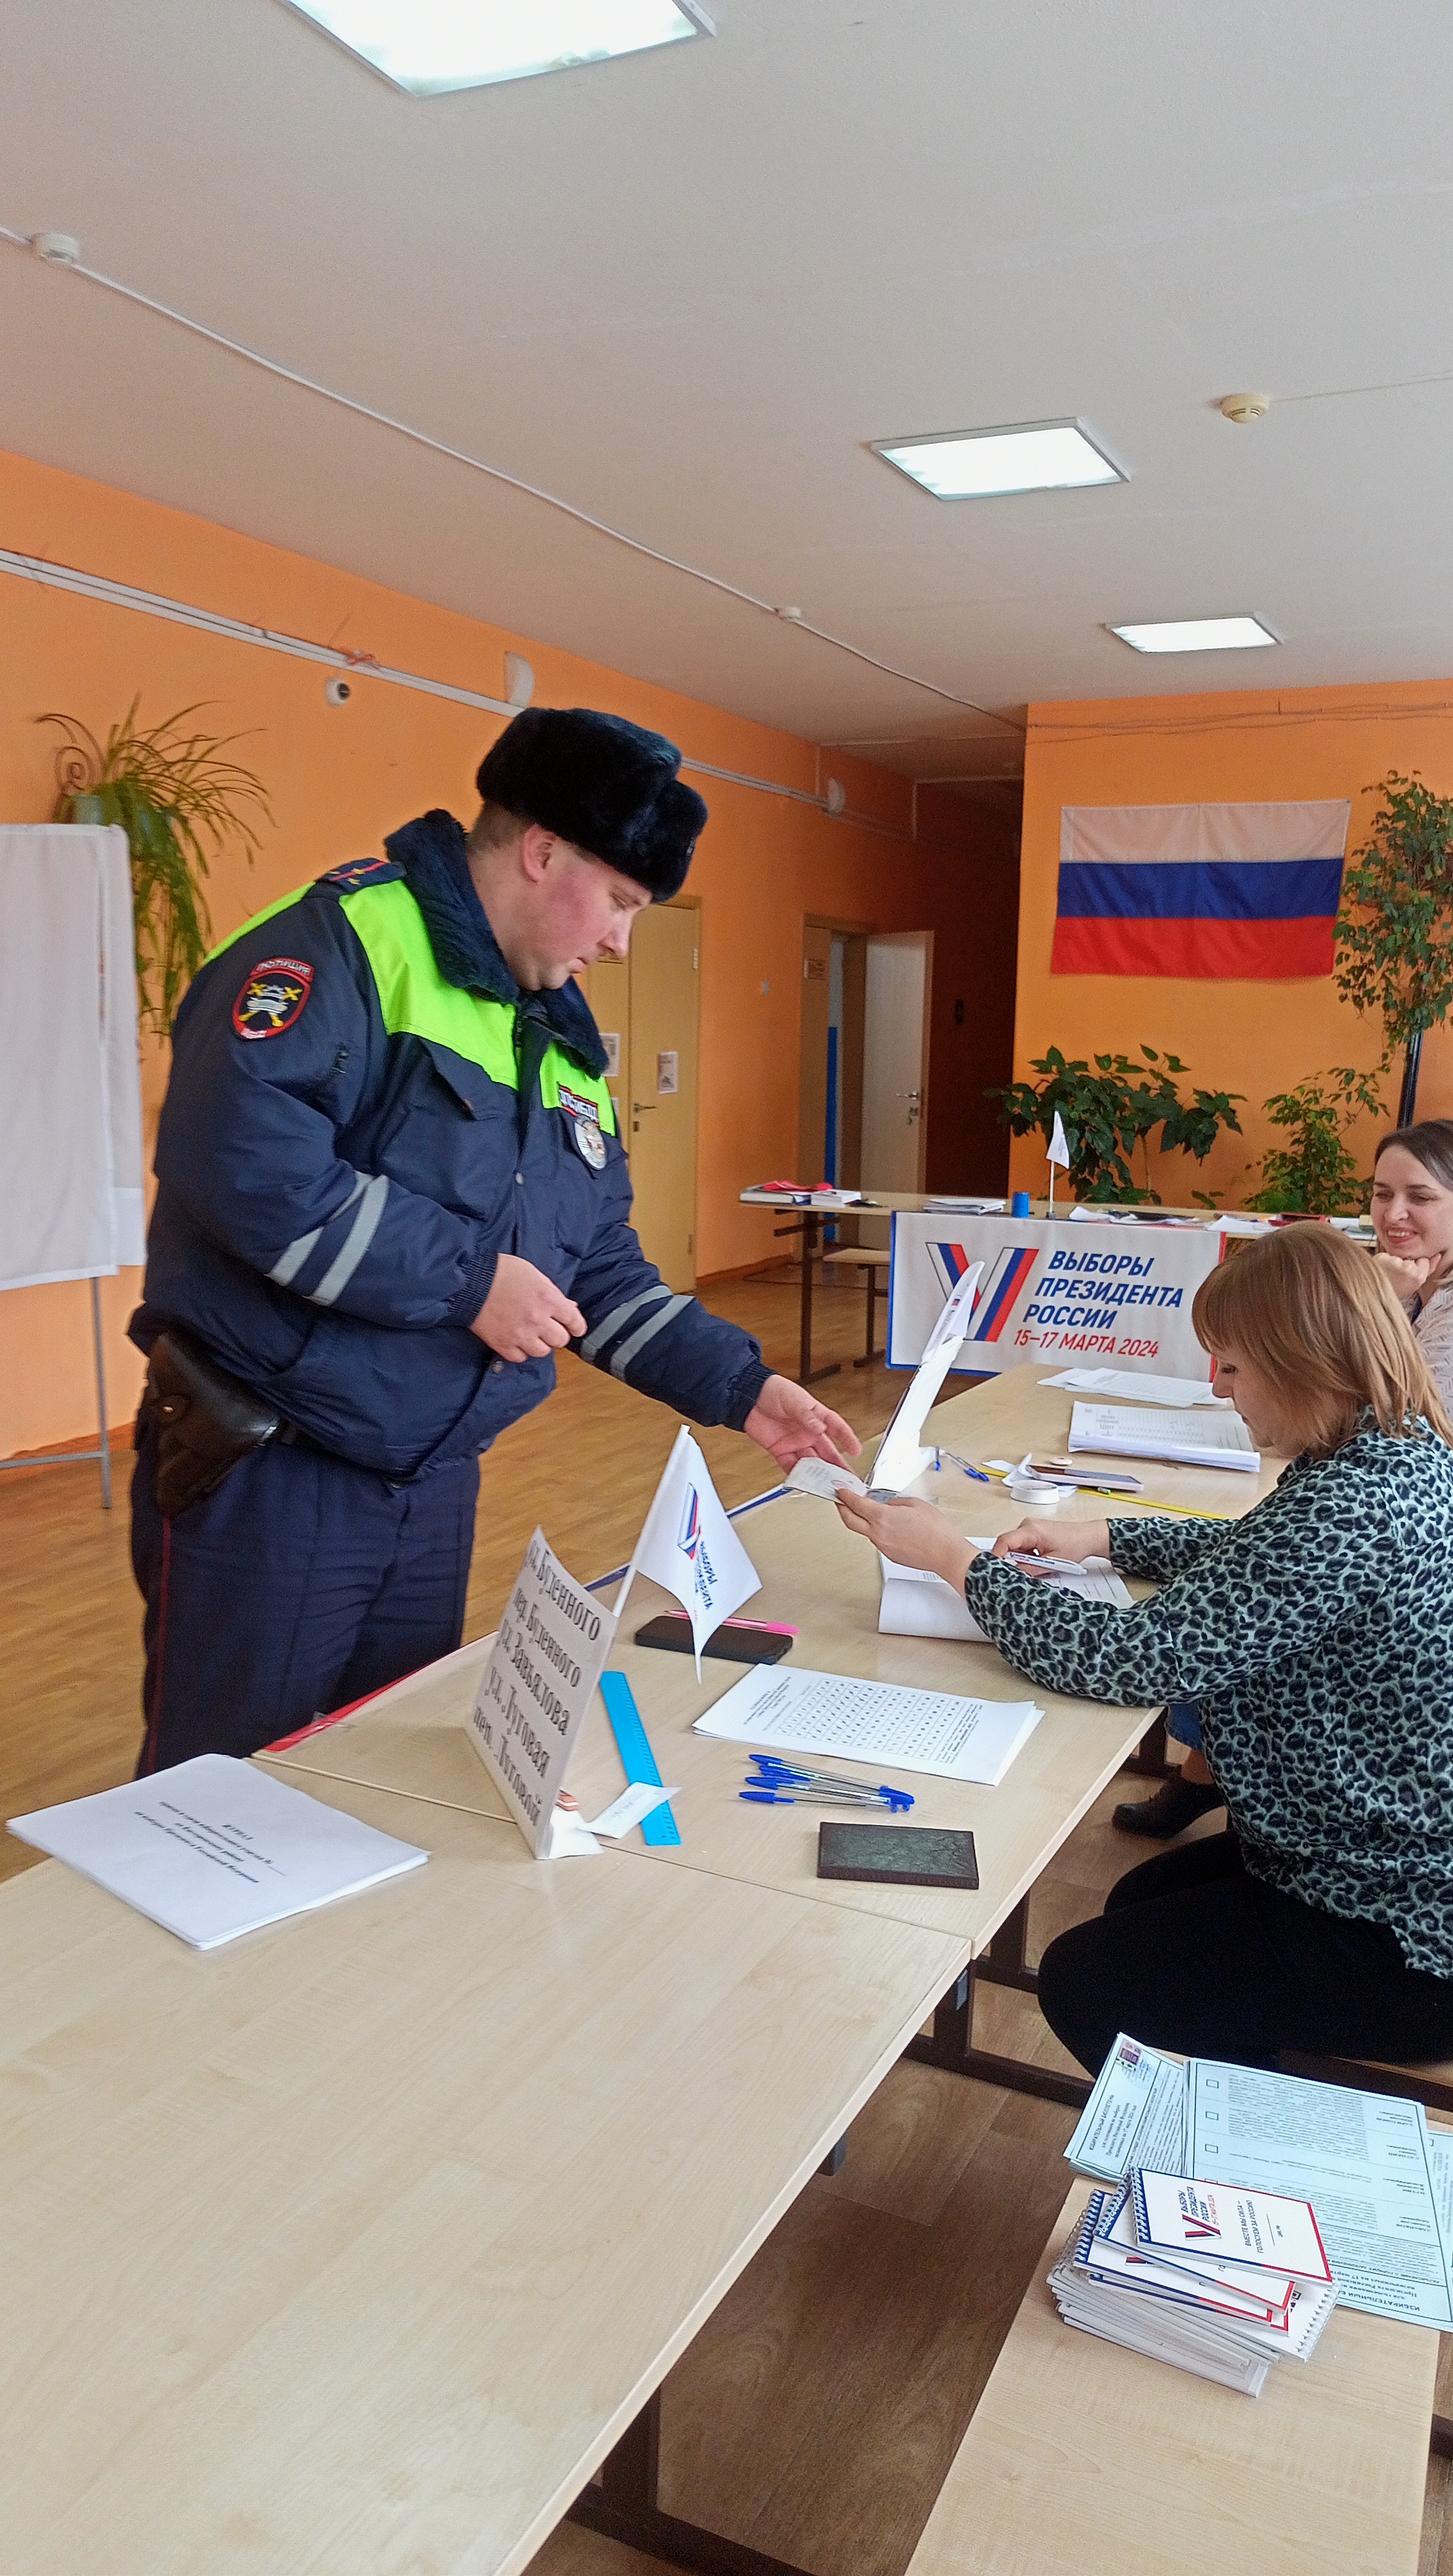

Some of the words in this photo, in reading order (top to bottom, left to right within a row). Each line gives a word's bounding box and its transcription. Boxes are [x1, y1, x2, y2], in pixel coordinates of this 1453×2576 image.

[1047, 1250, 1155, 1278] ВЫБОРЫ
[1034, 1278, 1184, 1308] ПРЕЗИДЕНТА
[1023, 1304, 1118, 1330] РОССИИ
[1058, 1333, 1114, 1355] МАРТА
[1117, 1338, 1159, 1359] 2024
[536, 1549, 602, 1641] Буденного
[526, 1604, 582, 1688] Буденного
[501, 1683, 550, 1779] Луговая
[494, 1733, 542, 1827] Луговой
[1348, 2292, 1420, 2311] ИЗБИРАТЕЛЬНЫЙ
